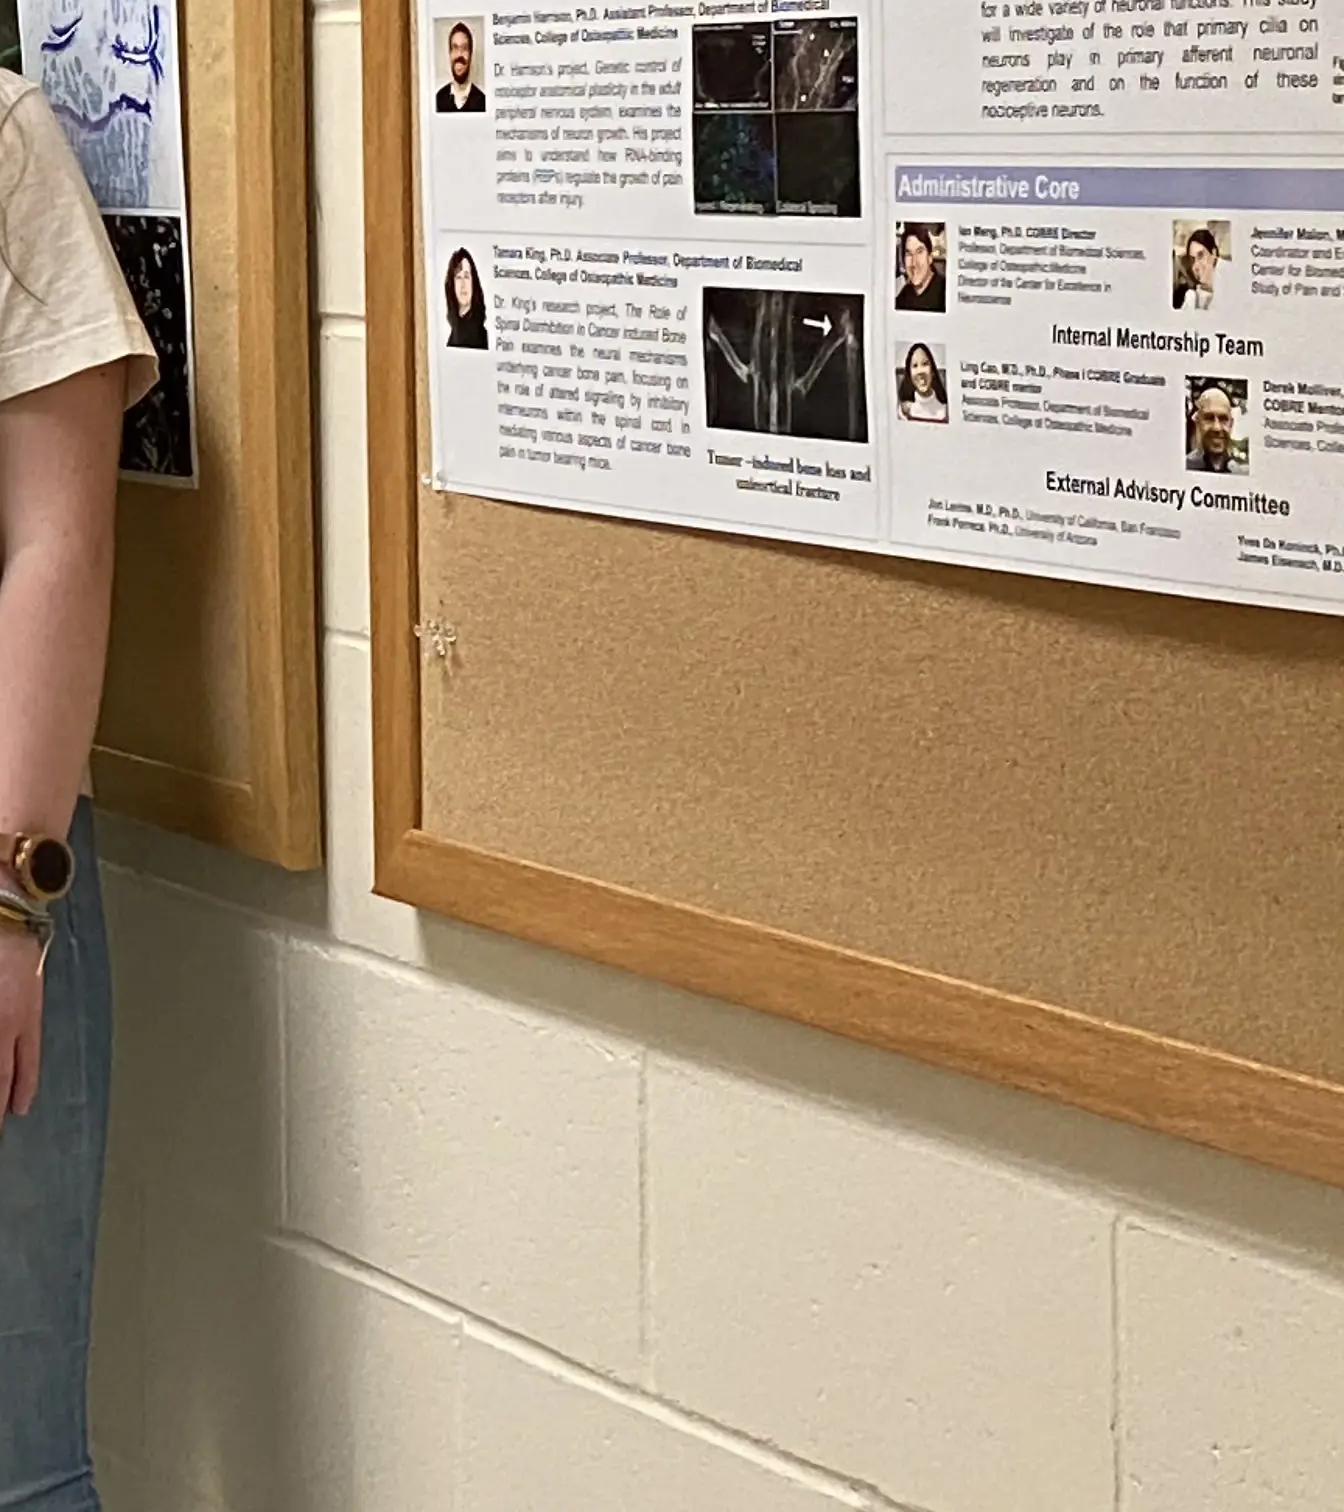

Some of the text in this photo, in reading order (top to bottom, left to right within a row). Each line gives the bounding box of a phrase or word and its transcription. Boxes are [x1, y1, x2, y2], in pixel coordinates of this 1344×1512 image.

[898, 173, 1080, 199] Administrative Core
[1051, 324, 1264, 357] Internal Mentorship Team
[1045, 470, 1291, 517] External Advisory Committee
